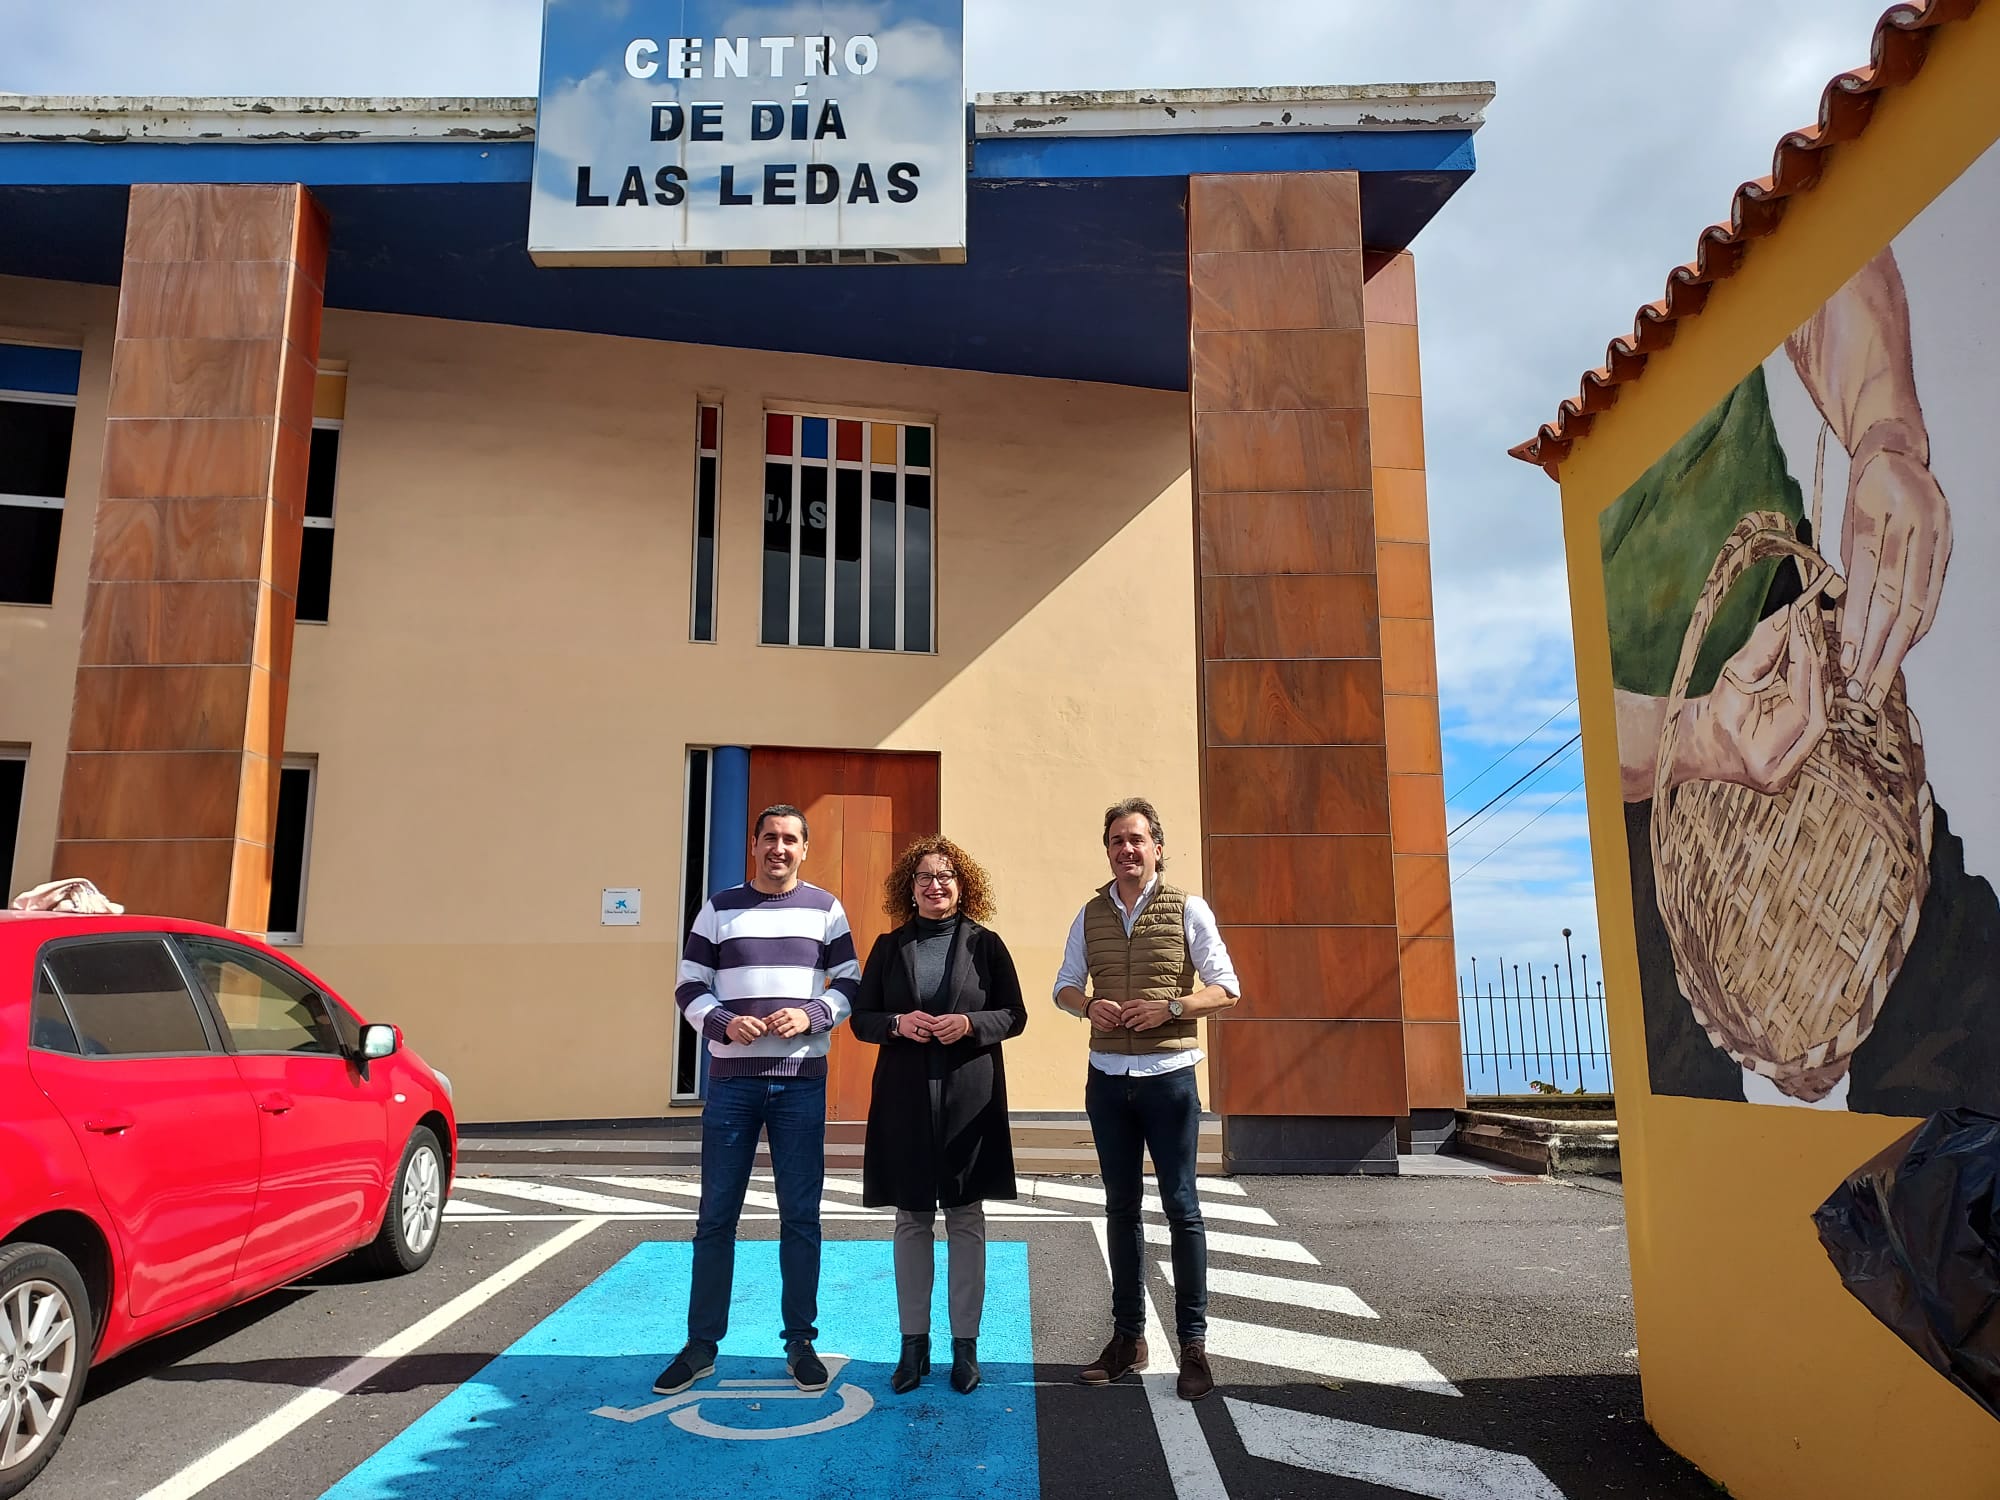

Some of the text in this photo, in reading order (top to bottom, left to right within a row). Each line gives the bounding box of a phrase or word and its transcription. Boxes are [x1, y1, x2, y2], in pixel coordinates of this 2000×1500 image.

[625, 35, 879, 79] CENTRO
[650, 82, 847, 142] DE DÍA
[575, 161, 921, 207] LAS LEDAS
